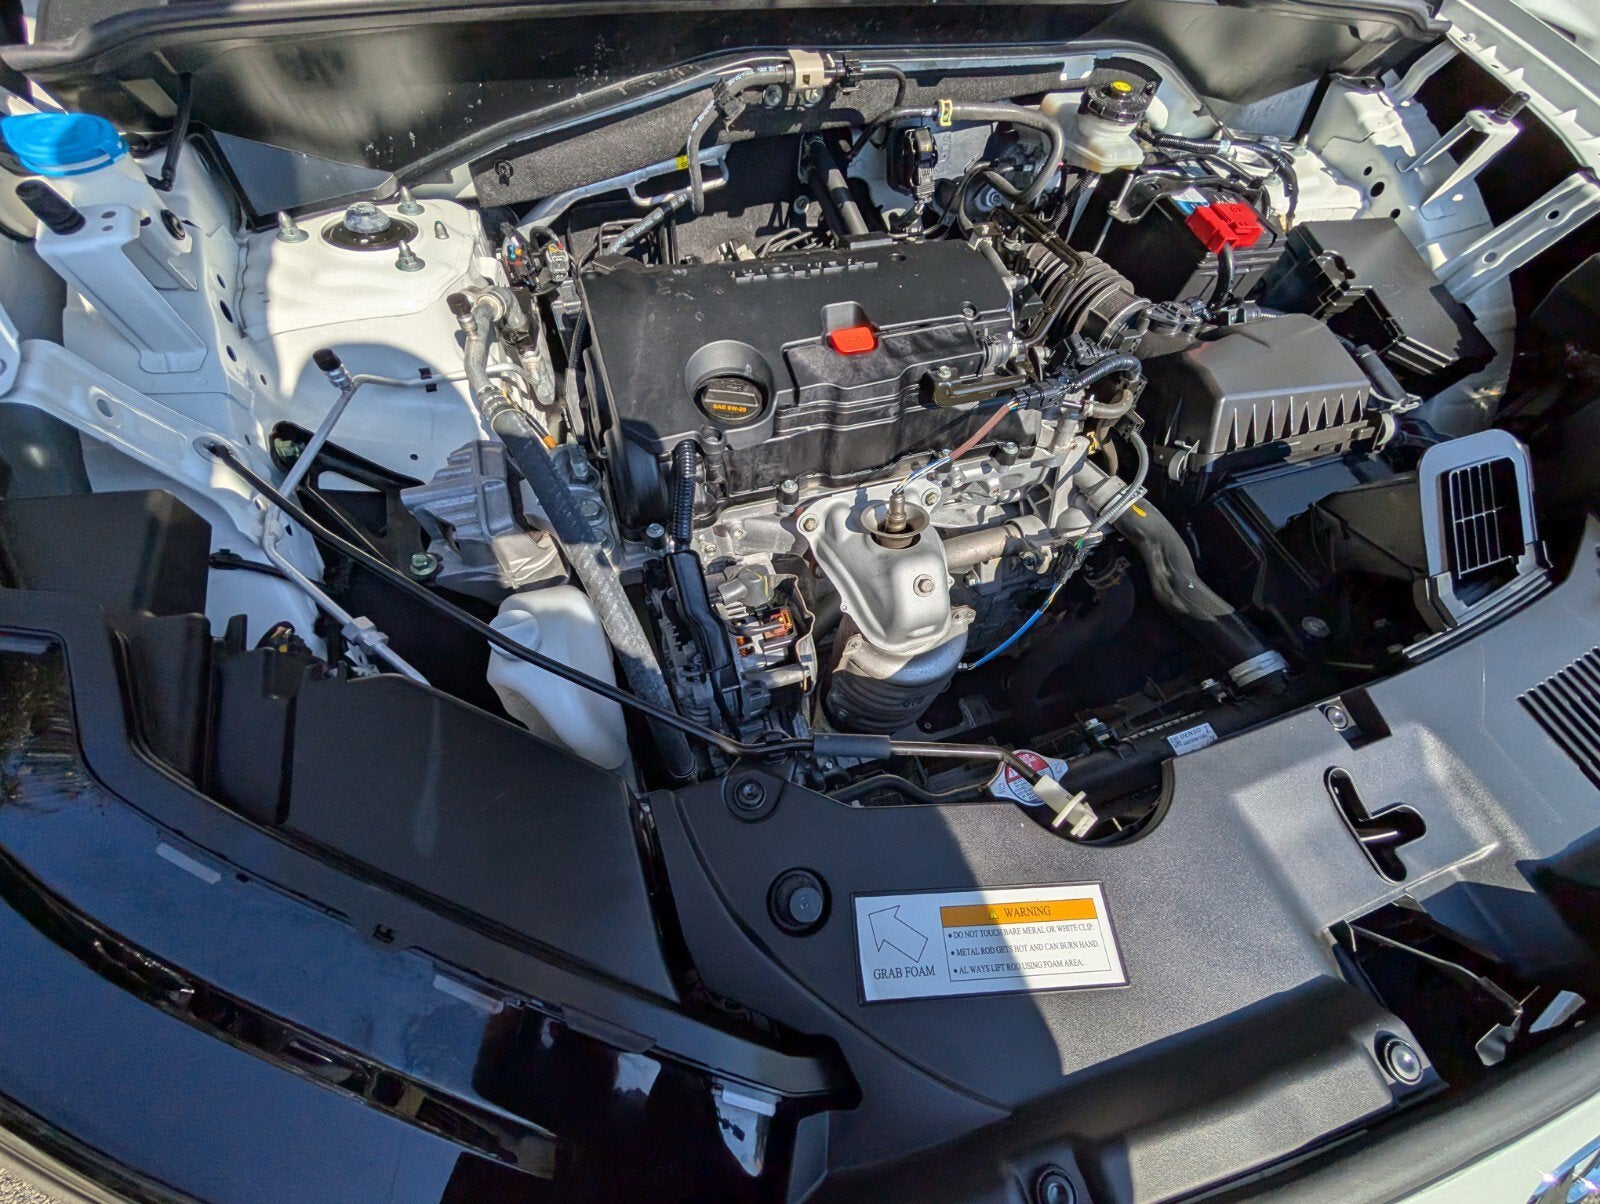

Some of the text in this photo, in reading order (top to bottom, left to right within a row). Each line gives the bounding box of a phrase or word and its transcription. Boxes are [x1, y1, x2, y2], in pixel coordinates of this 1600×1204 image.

[712, 403, 727, 411] SAE
[1180, 727, 1201, 740] DENSO
[1004, 905, 1051, 918] WARNING
[953, 931, 964, 939] DO
[964, 930, 979, 938] NOT
[980, 929, 1003, 938] TOUCH
[1003, 927, 1021, 936] BARE
[1046, 925, 1057, 933] OR
[1056, 924, 1078, 932] WHITE
[956, 947, 980, 957] METAL
[981, 946, 996, 955] ROD
[996, 945, 1013, 954] GETS
[1014, 944, 1028, 953] HOT
[1029, 943, 1044, 952] AND
[1044, 942, 1059, 951] CAN
[1059, 941, 1078, 950] BURN
[873, 965, 936, 980] GRAB FOAM
[990, 963, 1006, 972] LIFT
[1006, 962, 1021, 971] ROD
[1022, 961, 1043, 970] USING
[1043, 960, 1064, 968] FOAM
